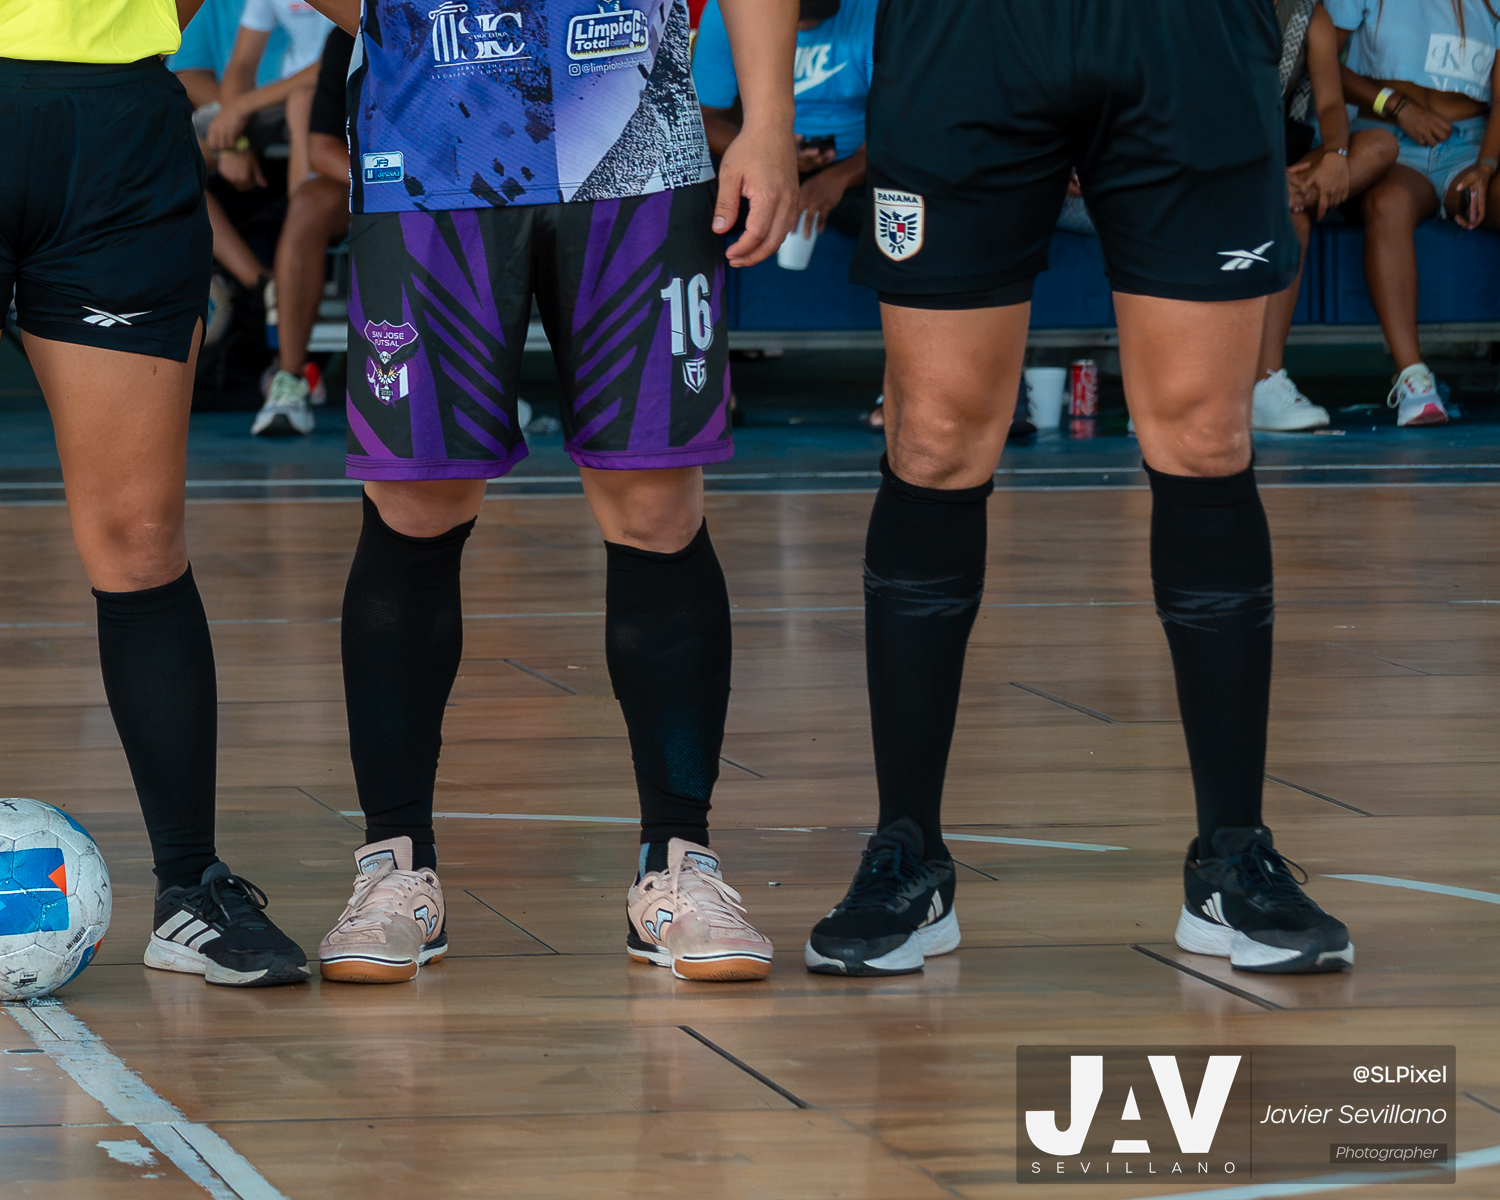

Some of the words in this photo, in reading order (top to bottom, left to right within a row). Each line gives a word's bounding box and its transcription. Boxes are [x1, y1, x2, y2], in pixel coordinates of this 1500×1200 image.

[575, 16, 632, 40] Limpio
[575, 37, 610, 51] Total
[660, 273, 714, 356] 16
[372, 330, 383, 338] SAN
[375, 339, 400, 347] FUTSAL
